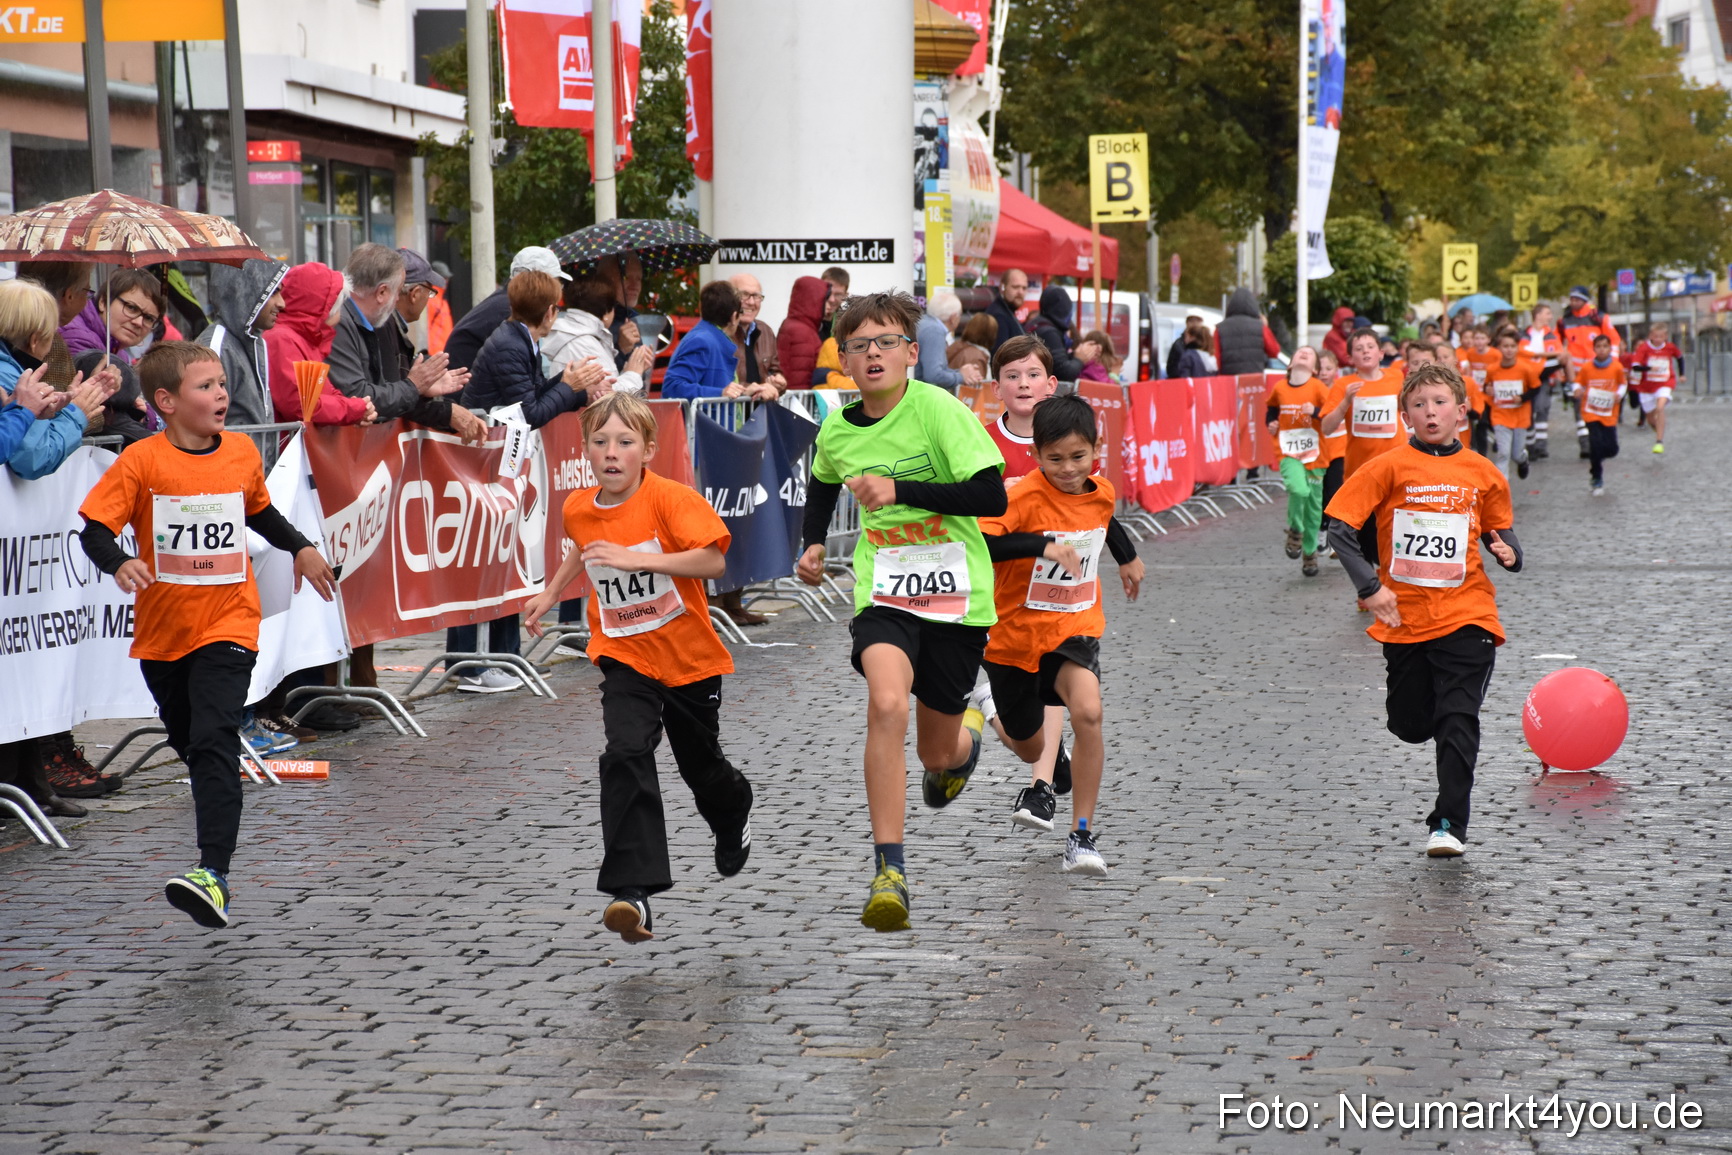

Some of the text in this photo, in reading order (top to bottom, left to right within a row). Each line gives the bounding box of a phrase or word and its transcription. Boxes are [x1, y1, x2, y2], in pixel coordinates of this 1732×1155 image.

[1097, 138, 1141, 154] Block
[1106, 161, 1133, 202] B
[719, 241, 888, 262] www.MINI-Partl.de
[1452, 259, 1468, 282] C
[1519, 285, 1531, 302] D
[1360, 409, 1390, 422] 7071
[1286, 438, 1313, 452] 7158
[1406, 484, 1460, 493] Neumarkter
[1406, 494, 1449, 503] Stadtlauf
[190, 503, 223, 513] BOCK
[168, 522, 234, 550] 7182
[1403, 533, 1457, 559] 7239
[193, 560, 214, 570] Luis
[909, 552, 942, 562] BOCK
[598, 570, 656, 604] 7147
[889, 571, 957, 597] 7049
[908, 598, 930, 608] Paul
[617, 605, 657, 621] Friedrich
[250, 761, 314, 772] BRANDIG
